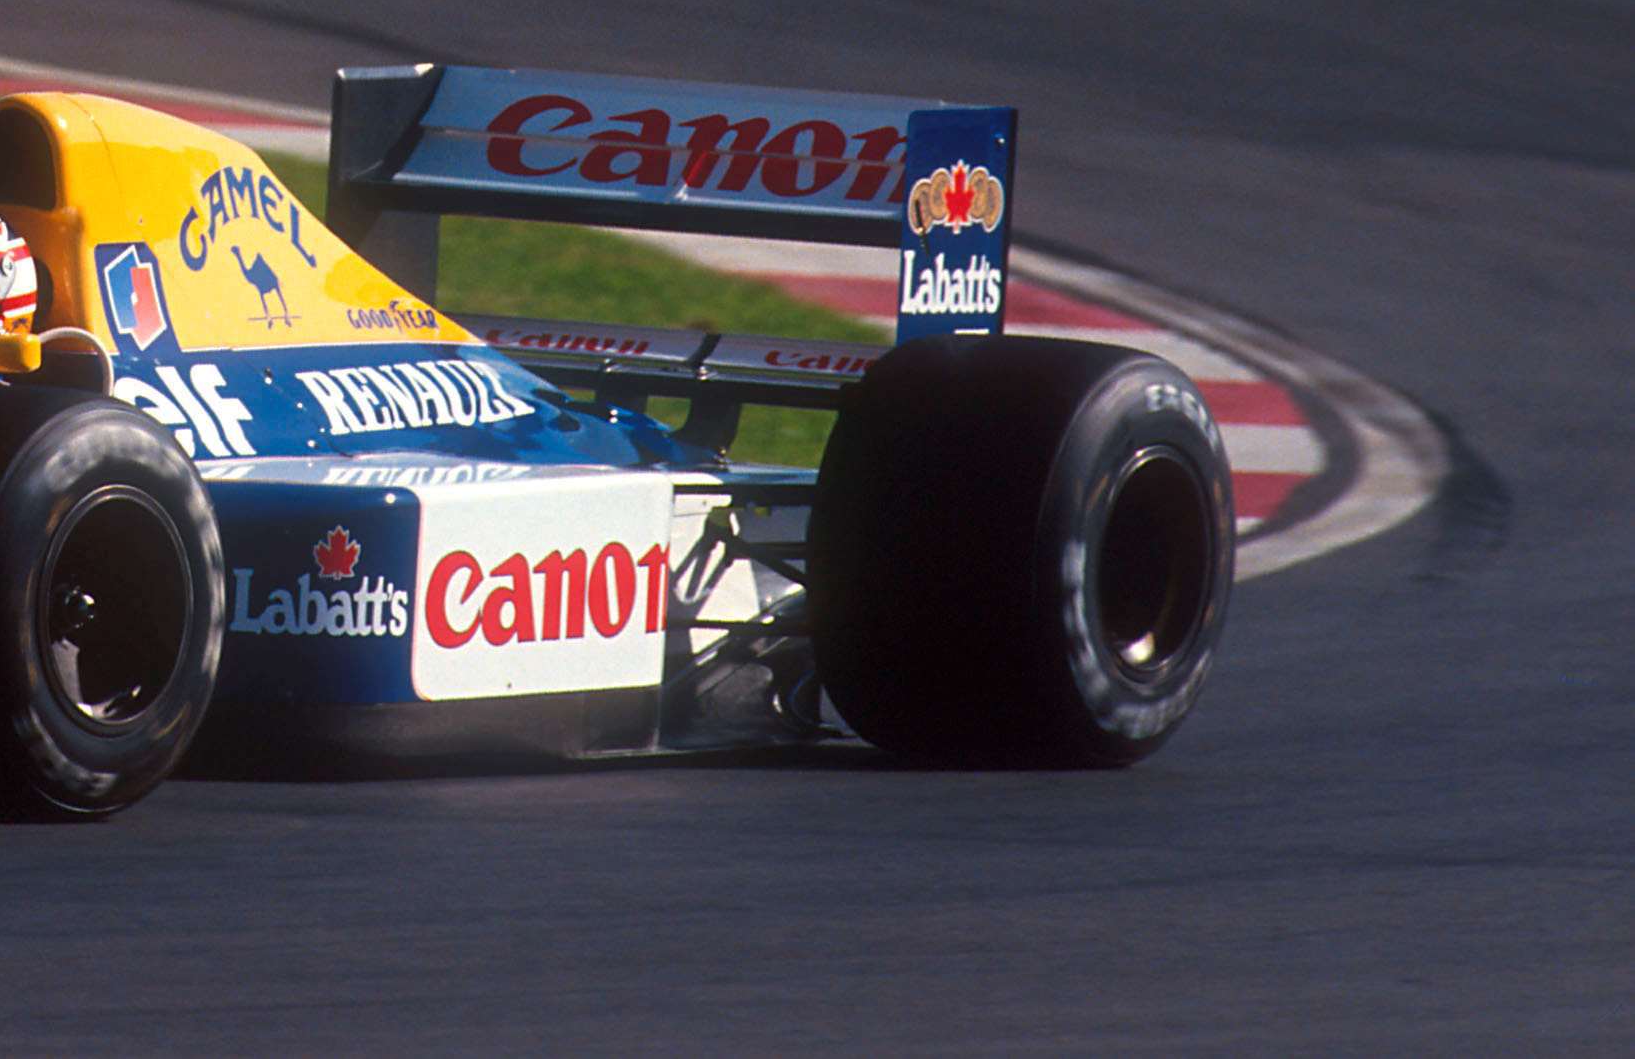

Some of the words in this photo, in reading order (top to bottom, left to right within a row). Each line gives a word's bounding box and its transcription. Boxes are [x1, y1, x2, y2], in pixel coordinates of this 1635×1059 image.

[180, 166, 317, 272] CAMEL
[900, 250, 1002, 315] Labatt's
[483, 327, 649, 356] Canon
[766, 349, 877, 374] Can
[295, 360, 536, 436] RENAULT
[230, 566, 409, 637] Labatt's
